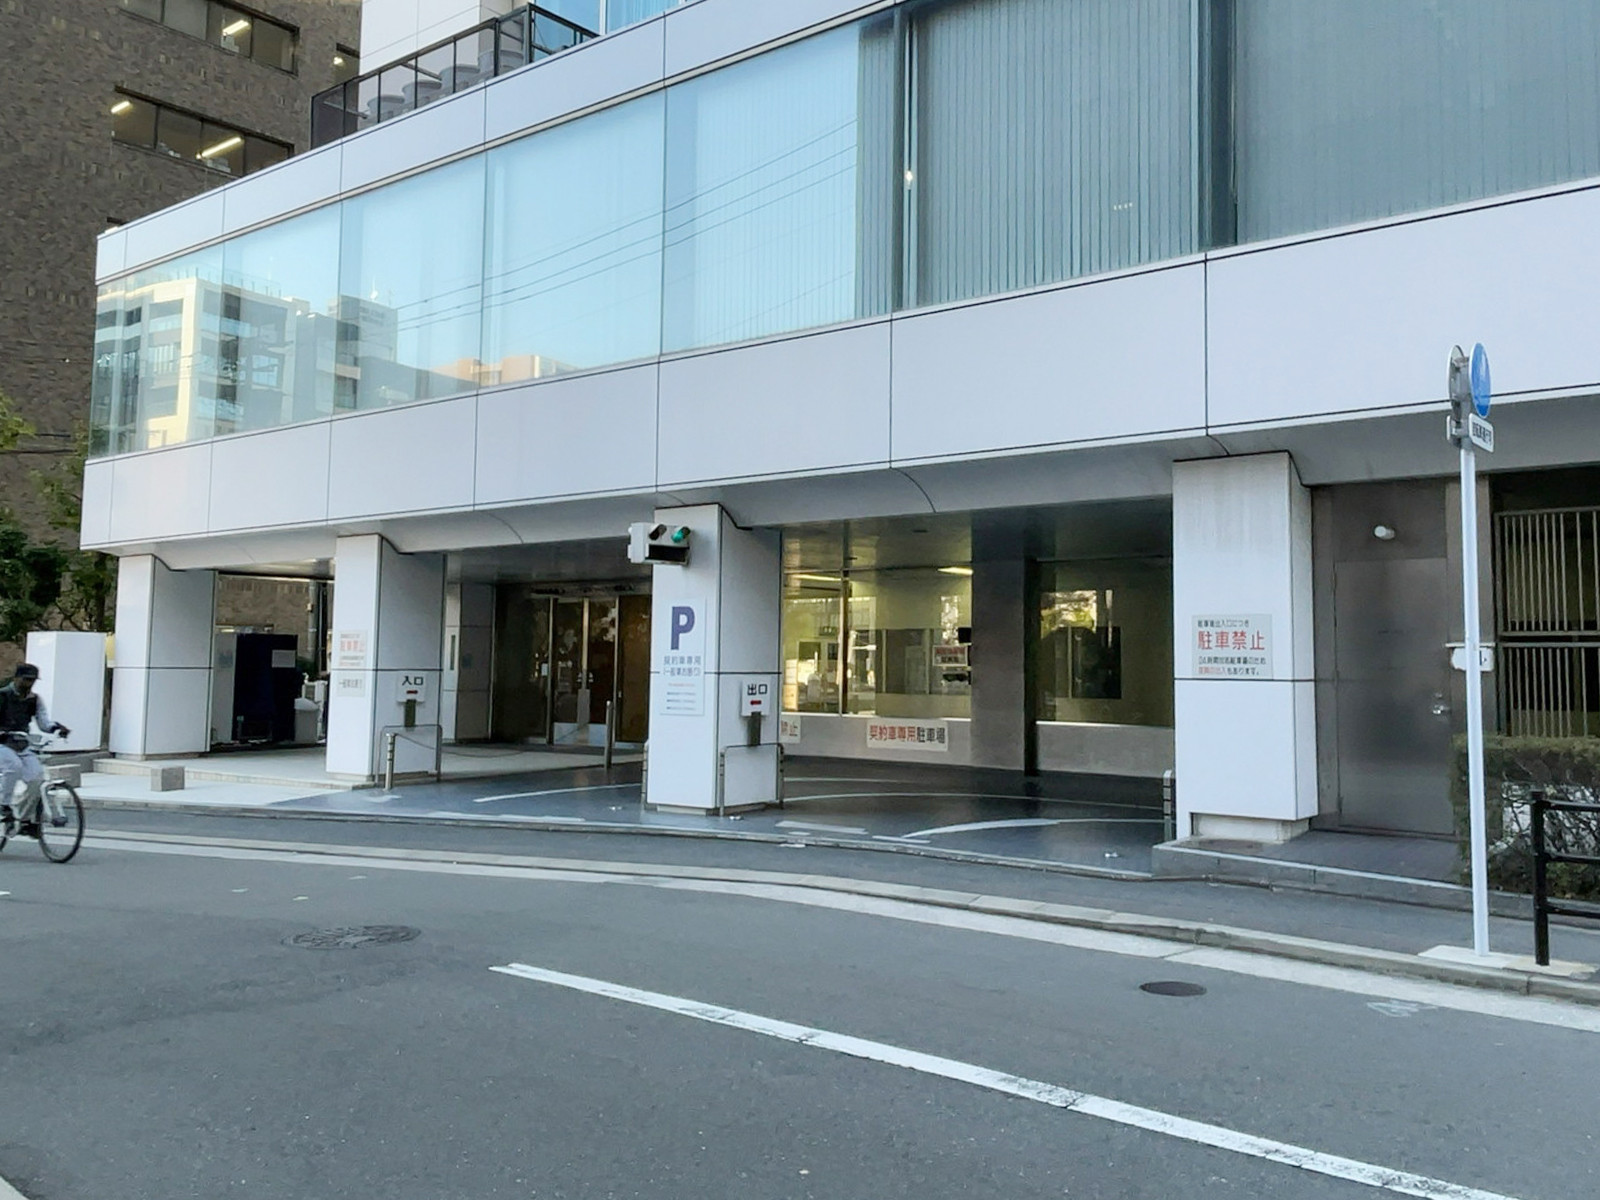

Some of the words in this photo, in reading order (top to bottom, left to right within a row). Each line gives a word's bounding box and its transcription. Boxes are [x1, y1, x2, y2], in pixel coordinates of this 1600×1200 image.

[671, 606, 695, 650] P
[1198, 630, 1265, 650] 駐車禁止
[402, 676, 423, 686] 入口
[747, 684, 768, 696] 出口
[870, 725, 946, 743] 契約車専用駐車場
